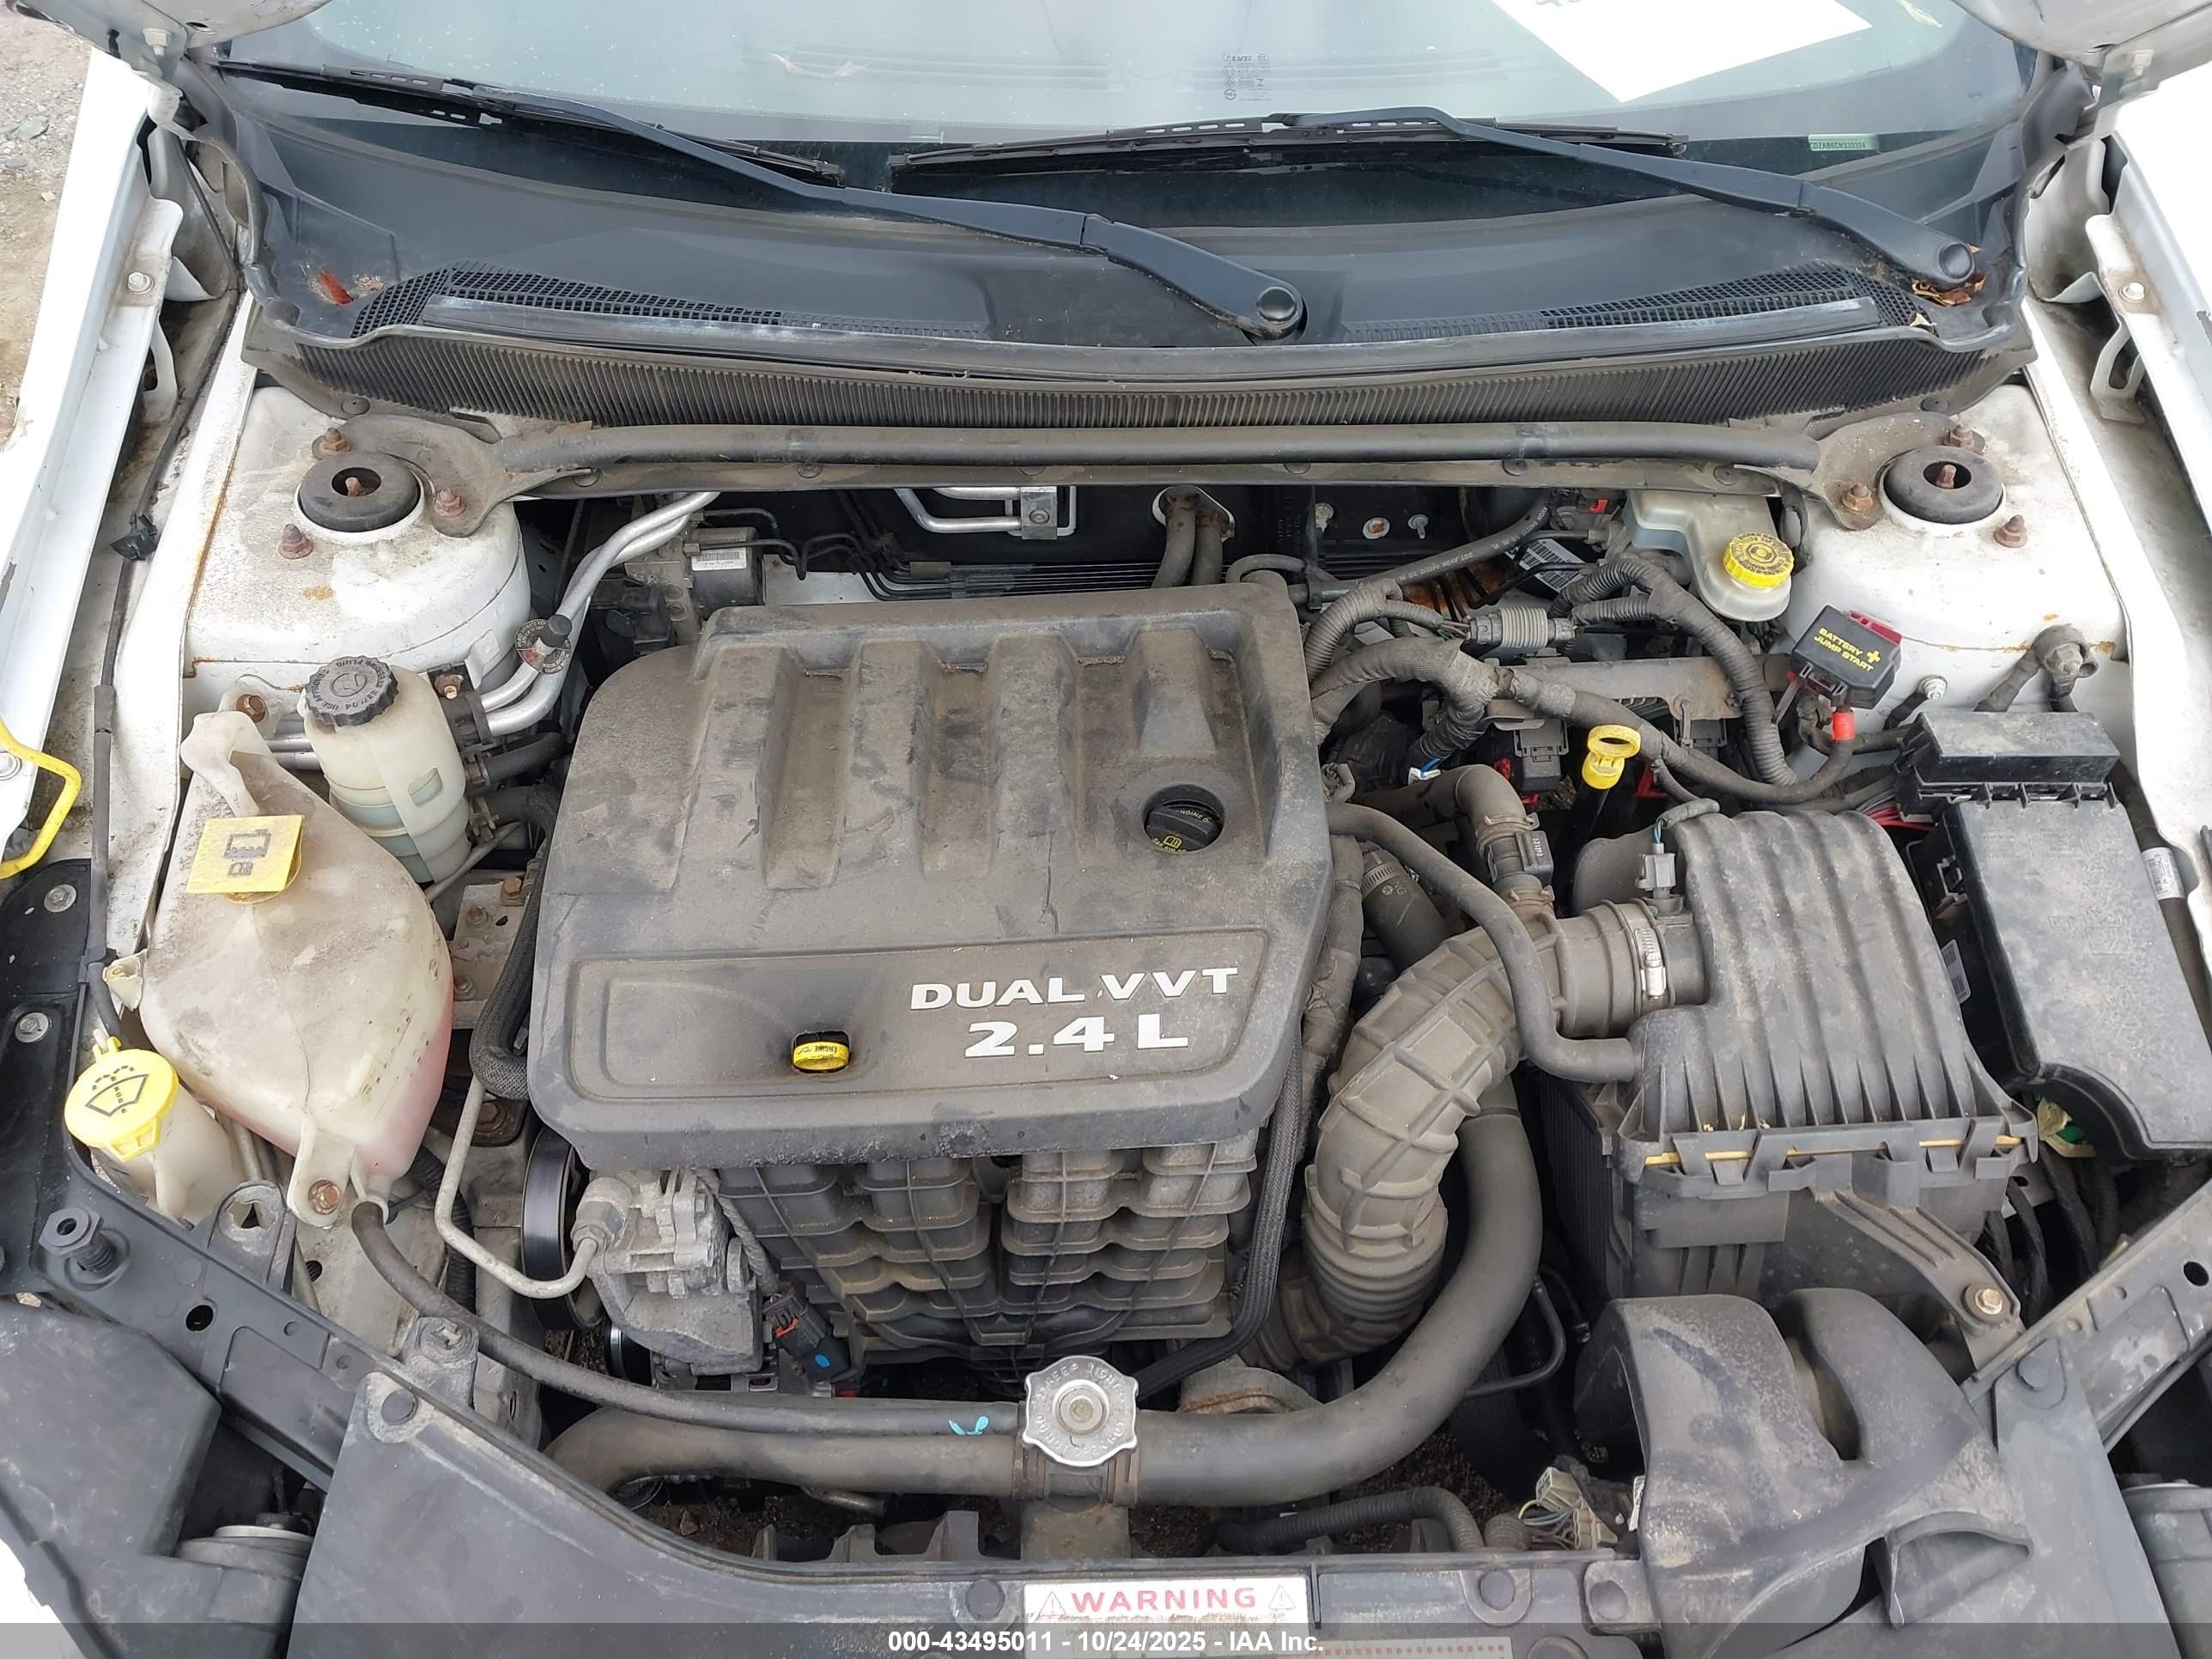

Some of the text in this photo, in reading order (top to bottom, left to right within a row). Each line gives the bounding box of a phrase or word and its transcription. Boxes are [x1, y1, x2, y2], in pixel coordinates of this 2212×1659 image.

[1814, 635, 1875, 672] JUMP START
[1819, 628, 1863, 656] BATTERY
[1176, 810, 1204, 819] NGINE
[910, 967, 1238, 1010] DUAL VVT
[964, 1013, 1188, 1058] 2.4 L
[1072, 1588, 1255, 1613] WARNING
